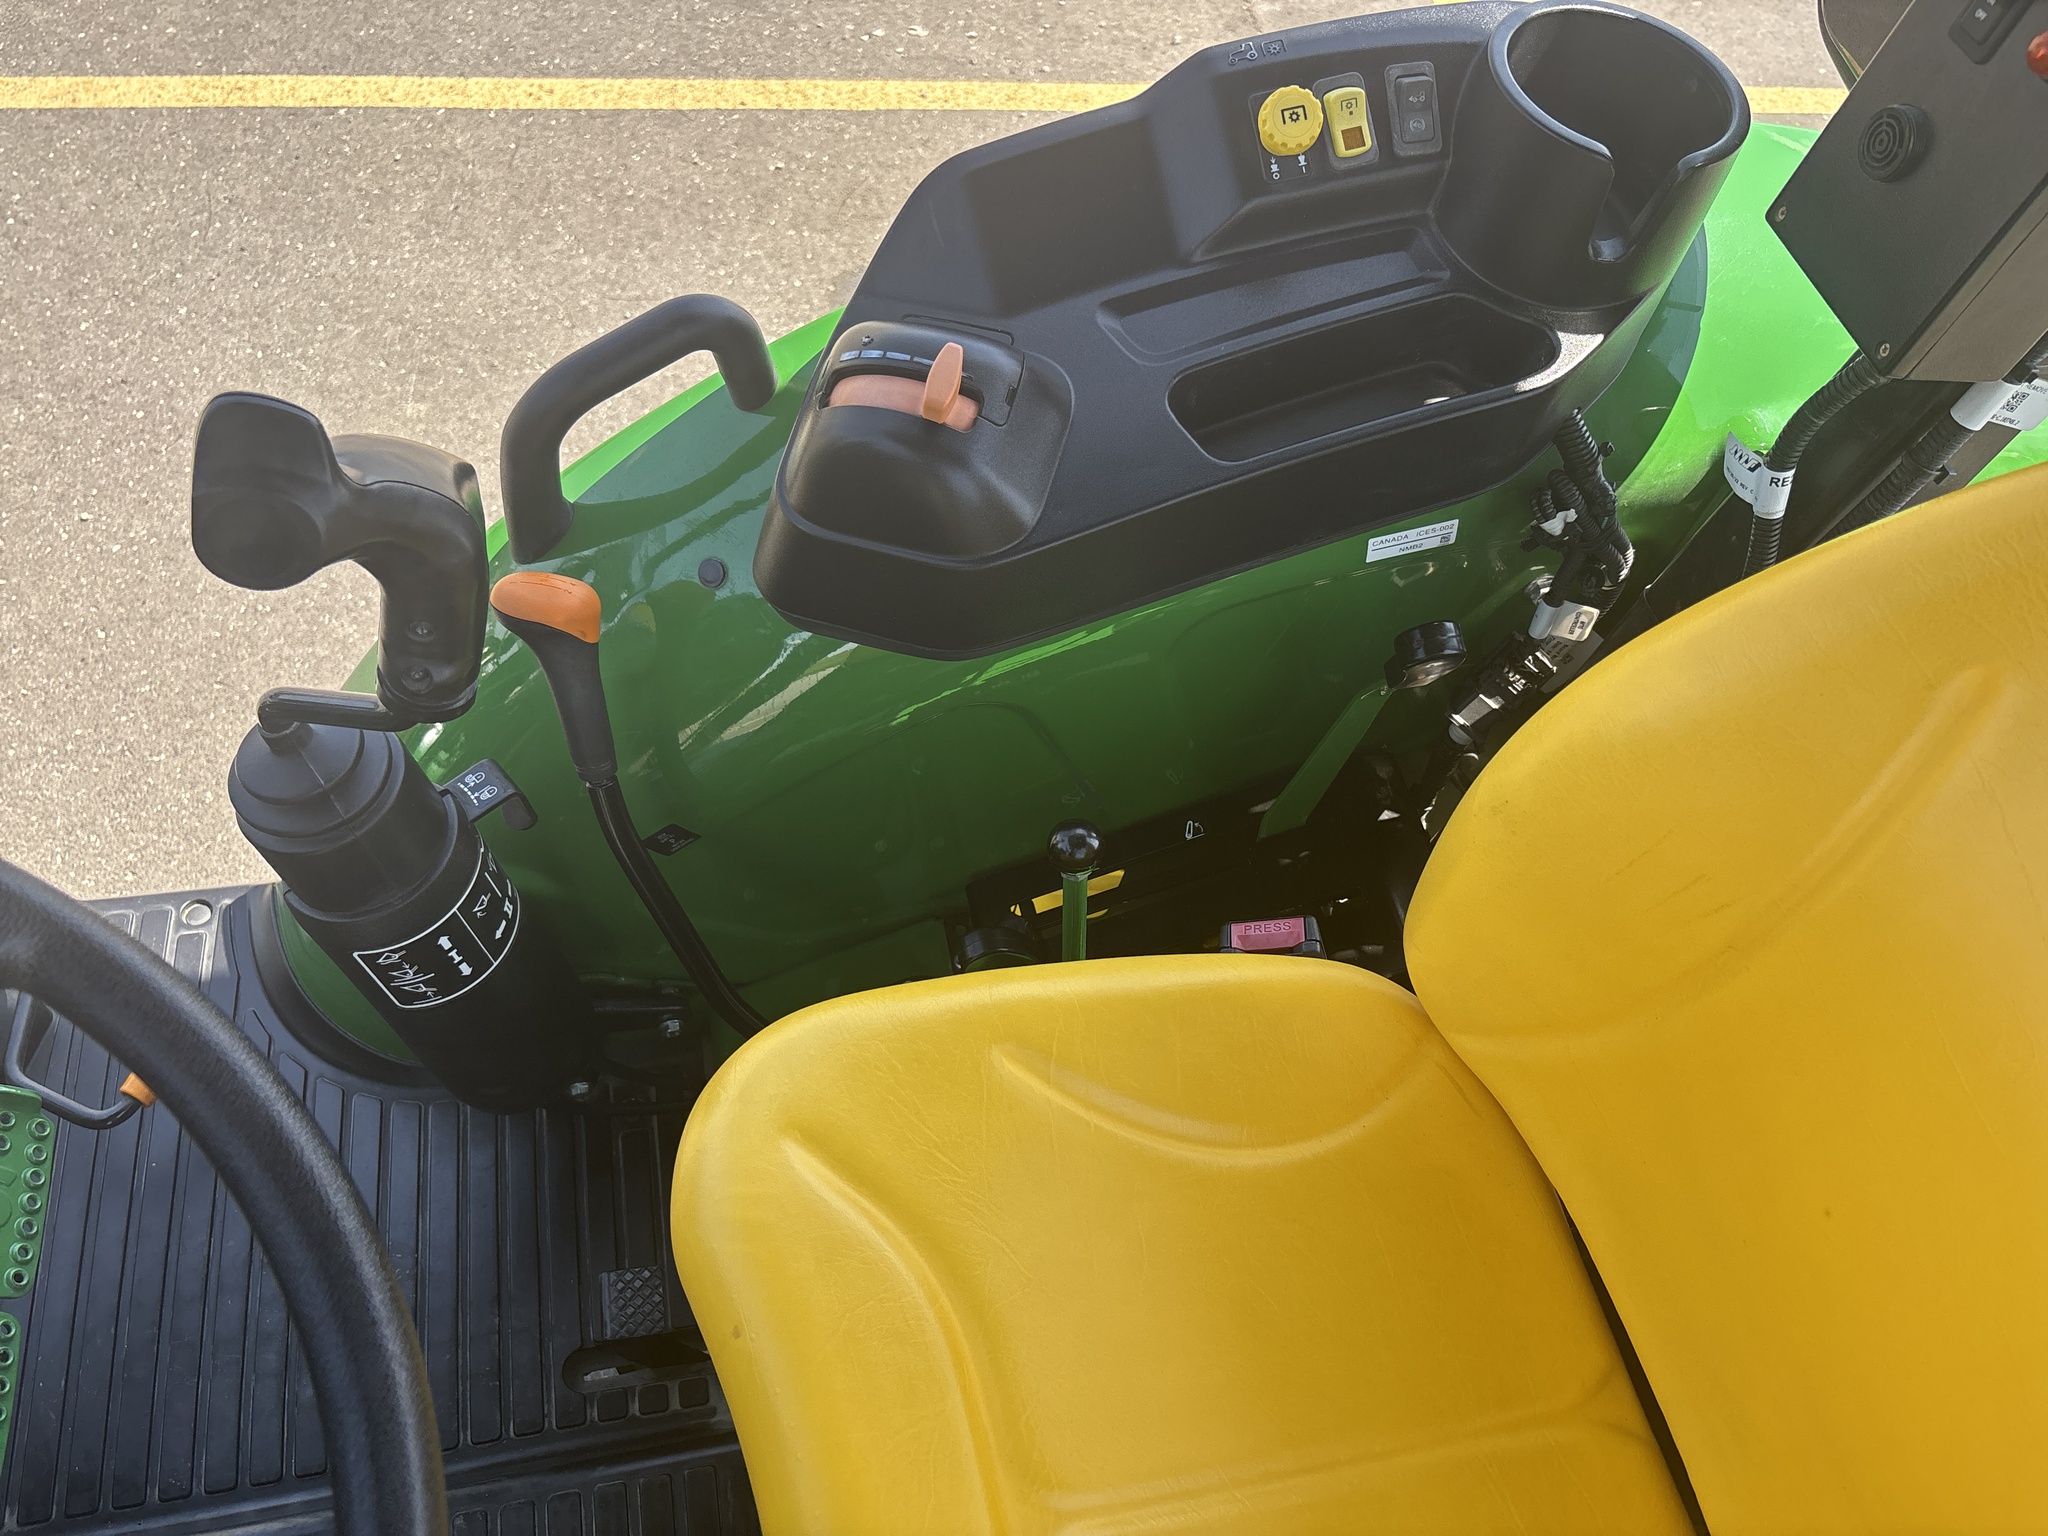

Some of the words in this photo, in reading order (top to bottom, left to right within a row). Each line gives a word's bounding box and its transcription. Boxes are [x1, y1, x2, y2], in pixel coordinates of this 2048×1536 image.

[1769, 476, 1794, 488] RE
[1371, 534, 1409, 547] CANADA
[1416, 523, 1455, 537] ICES-002
[1568, 611, 1582, 635] CONTROLLER
[1243, 921, 1292, 934] PRESS
